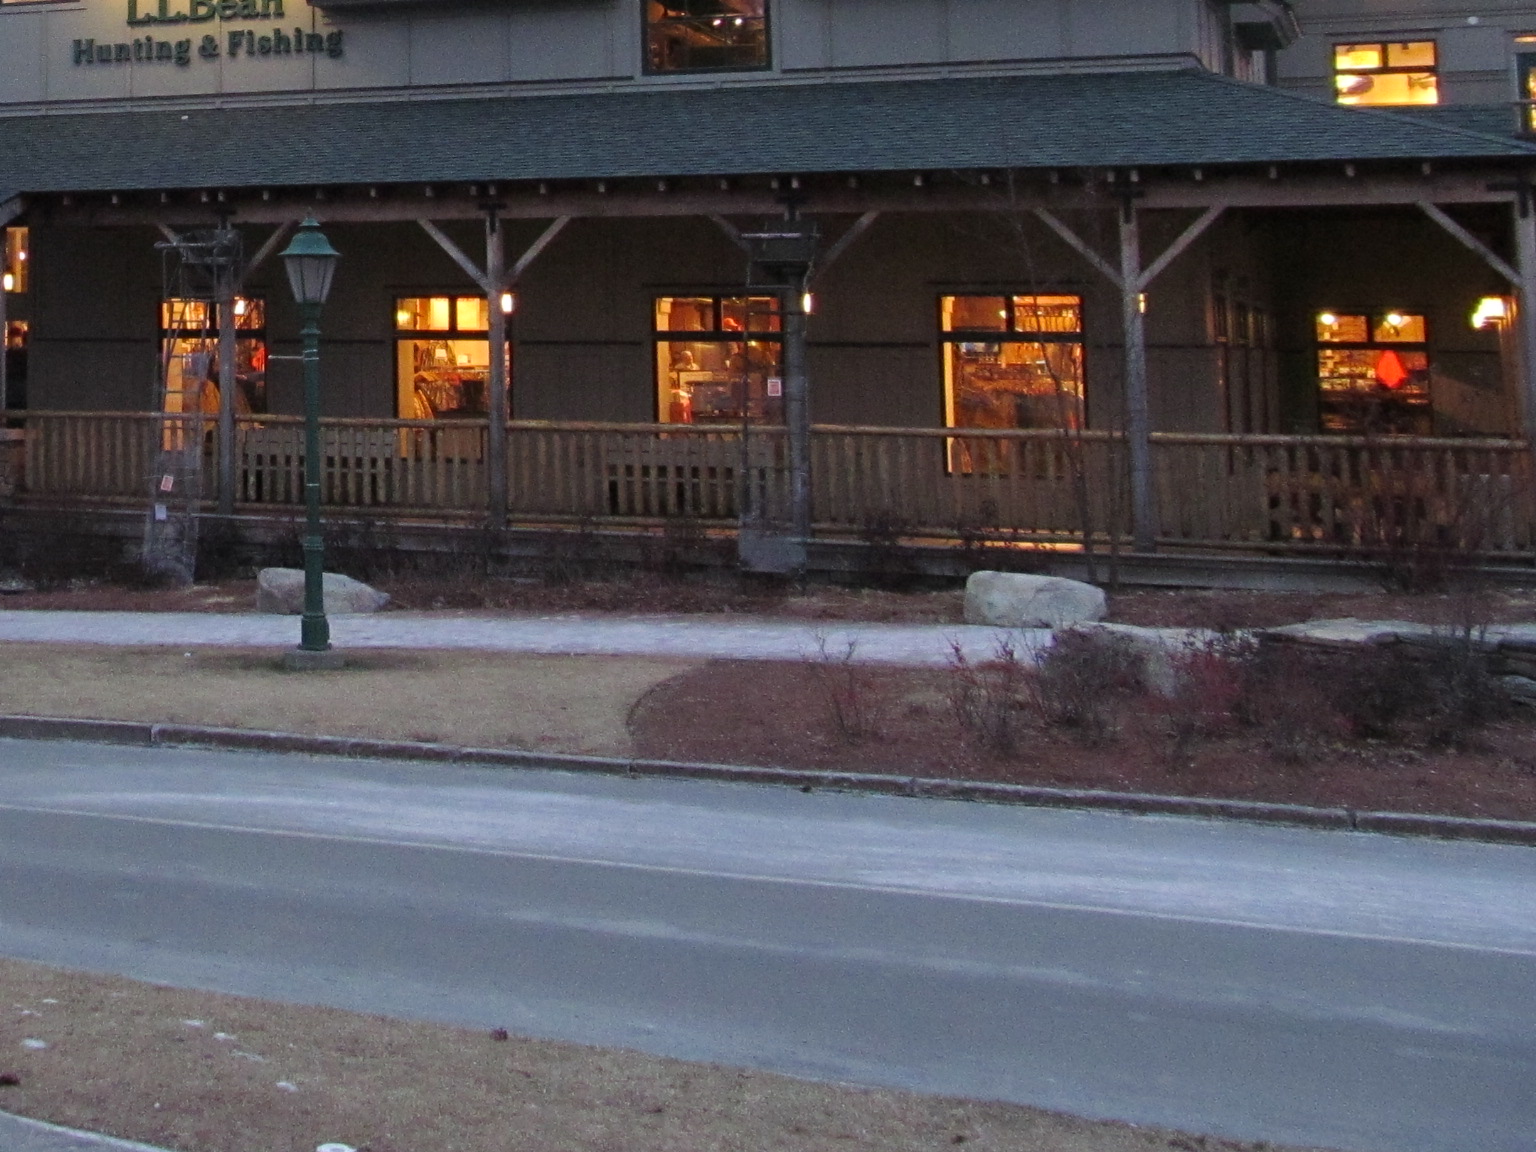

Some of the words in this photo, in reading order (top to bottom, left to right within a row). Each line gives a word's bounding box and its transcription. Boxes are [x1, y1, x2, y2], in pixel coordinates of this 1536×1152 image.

[73, 35, 192, 65] Hunting
[198, 34, 219, 58] &
[227, 27, 344, 58] Fishing
